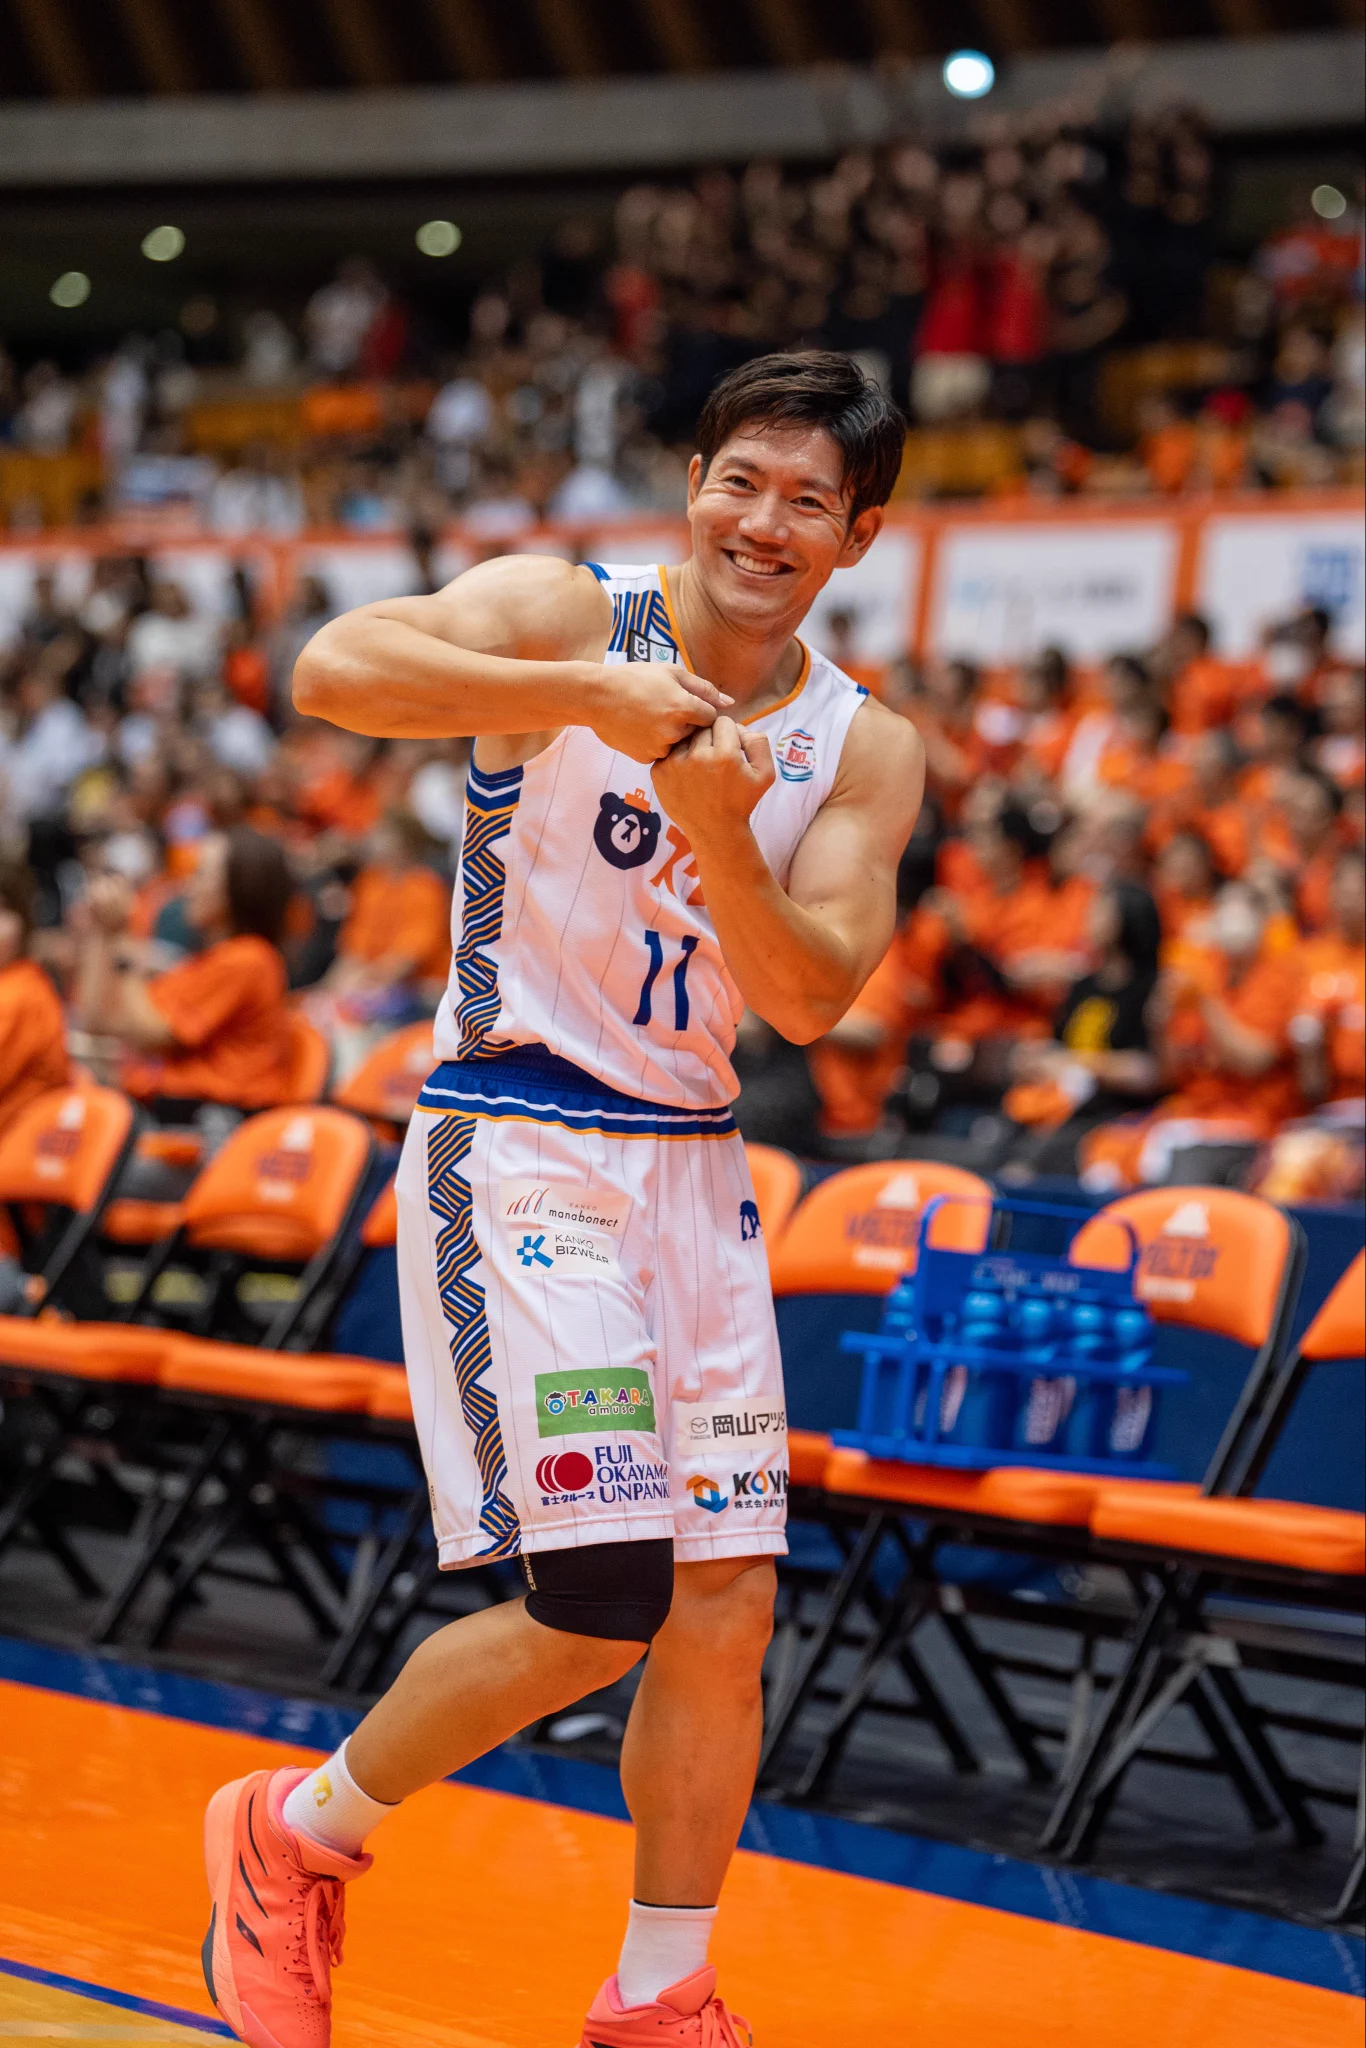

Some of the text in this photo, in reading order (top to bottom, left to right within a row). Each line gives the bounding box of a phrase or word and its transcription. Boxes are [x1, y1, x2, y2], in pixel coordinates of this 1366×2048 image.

[633, 930, 700, 1031] 11
[569, 1202, 598, 1211] KANKO
[548, 1209, 618, 1227] manabonect
[555, 1234, 594, 1250] KANKO
[556, 1246, 610, 1265] BIZWEAR
[588, 1406, 635, 1415] amuse
[594, 1444, 633, 1465] FUJI
[597, 1463, 668, 1484] OKAYAMA
